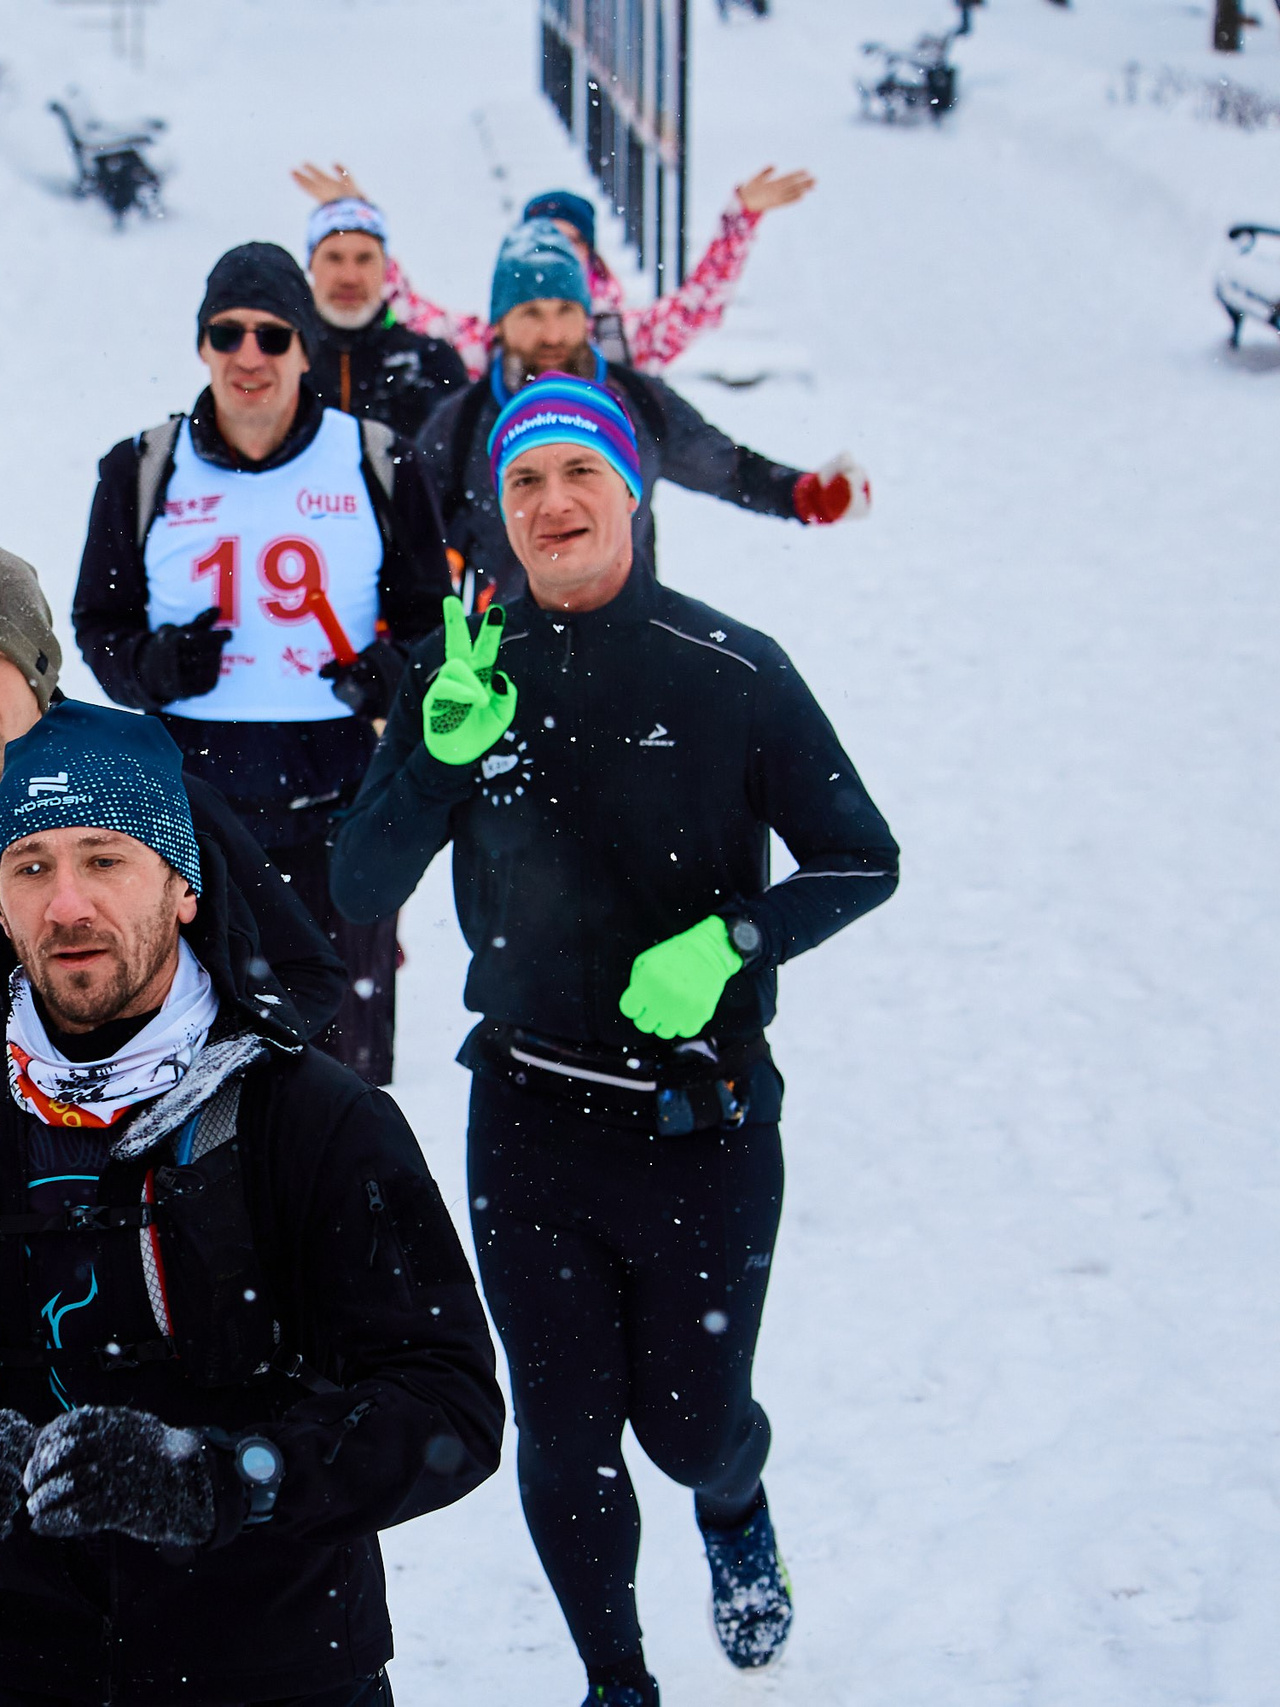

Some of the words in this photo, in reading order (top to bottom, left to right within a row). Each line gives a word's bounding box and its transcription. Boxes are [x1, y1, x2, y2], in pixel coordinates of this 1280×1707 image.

[306, 493, 357, 514] HUB
[190, 533, 329, 628] 19
[14, 795, 94, 816] NORDSKI
